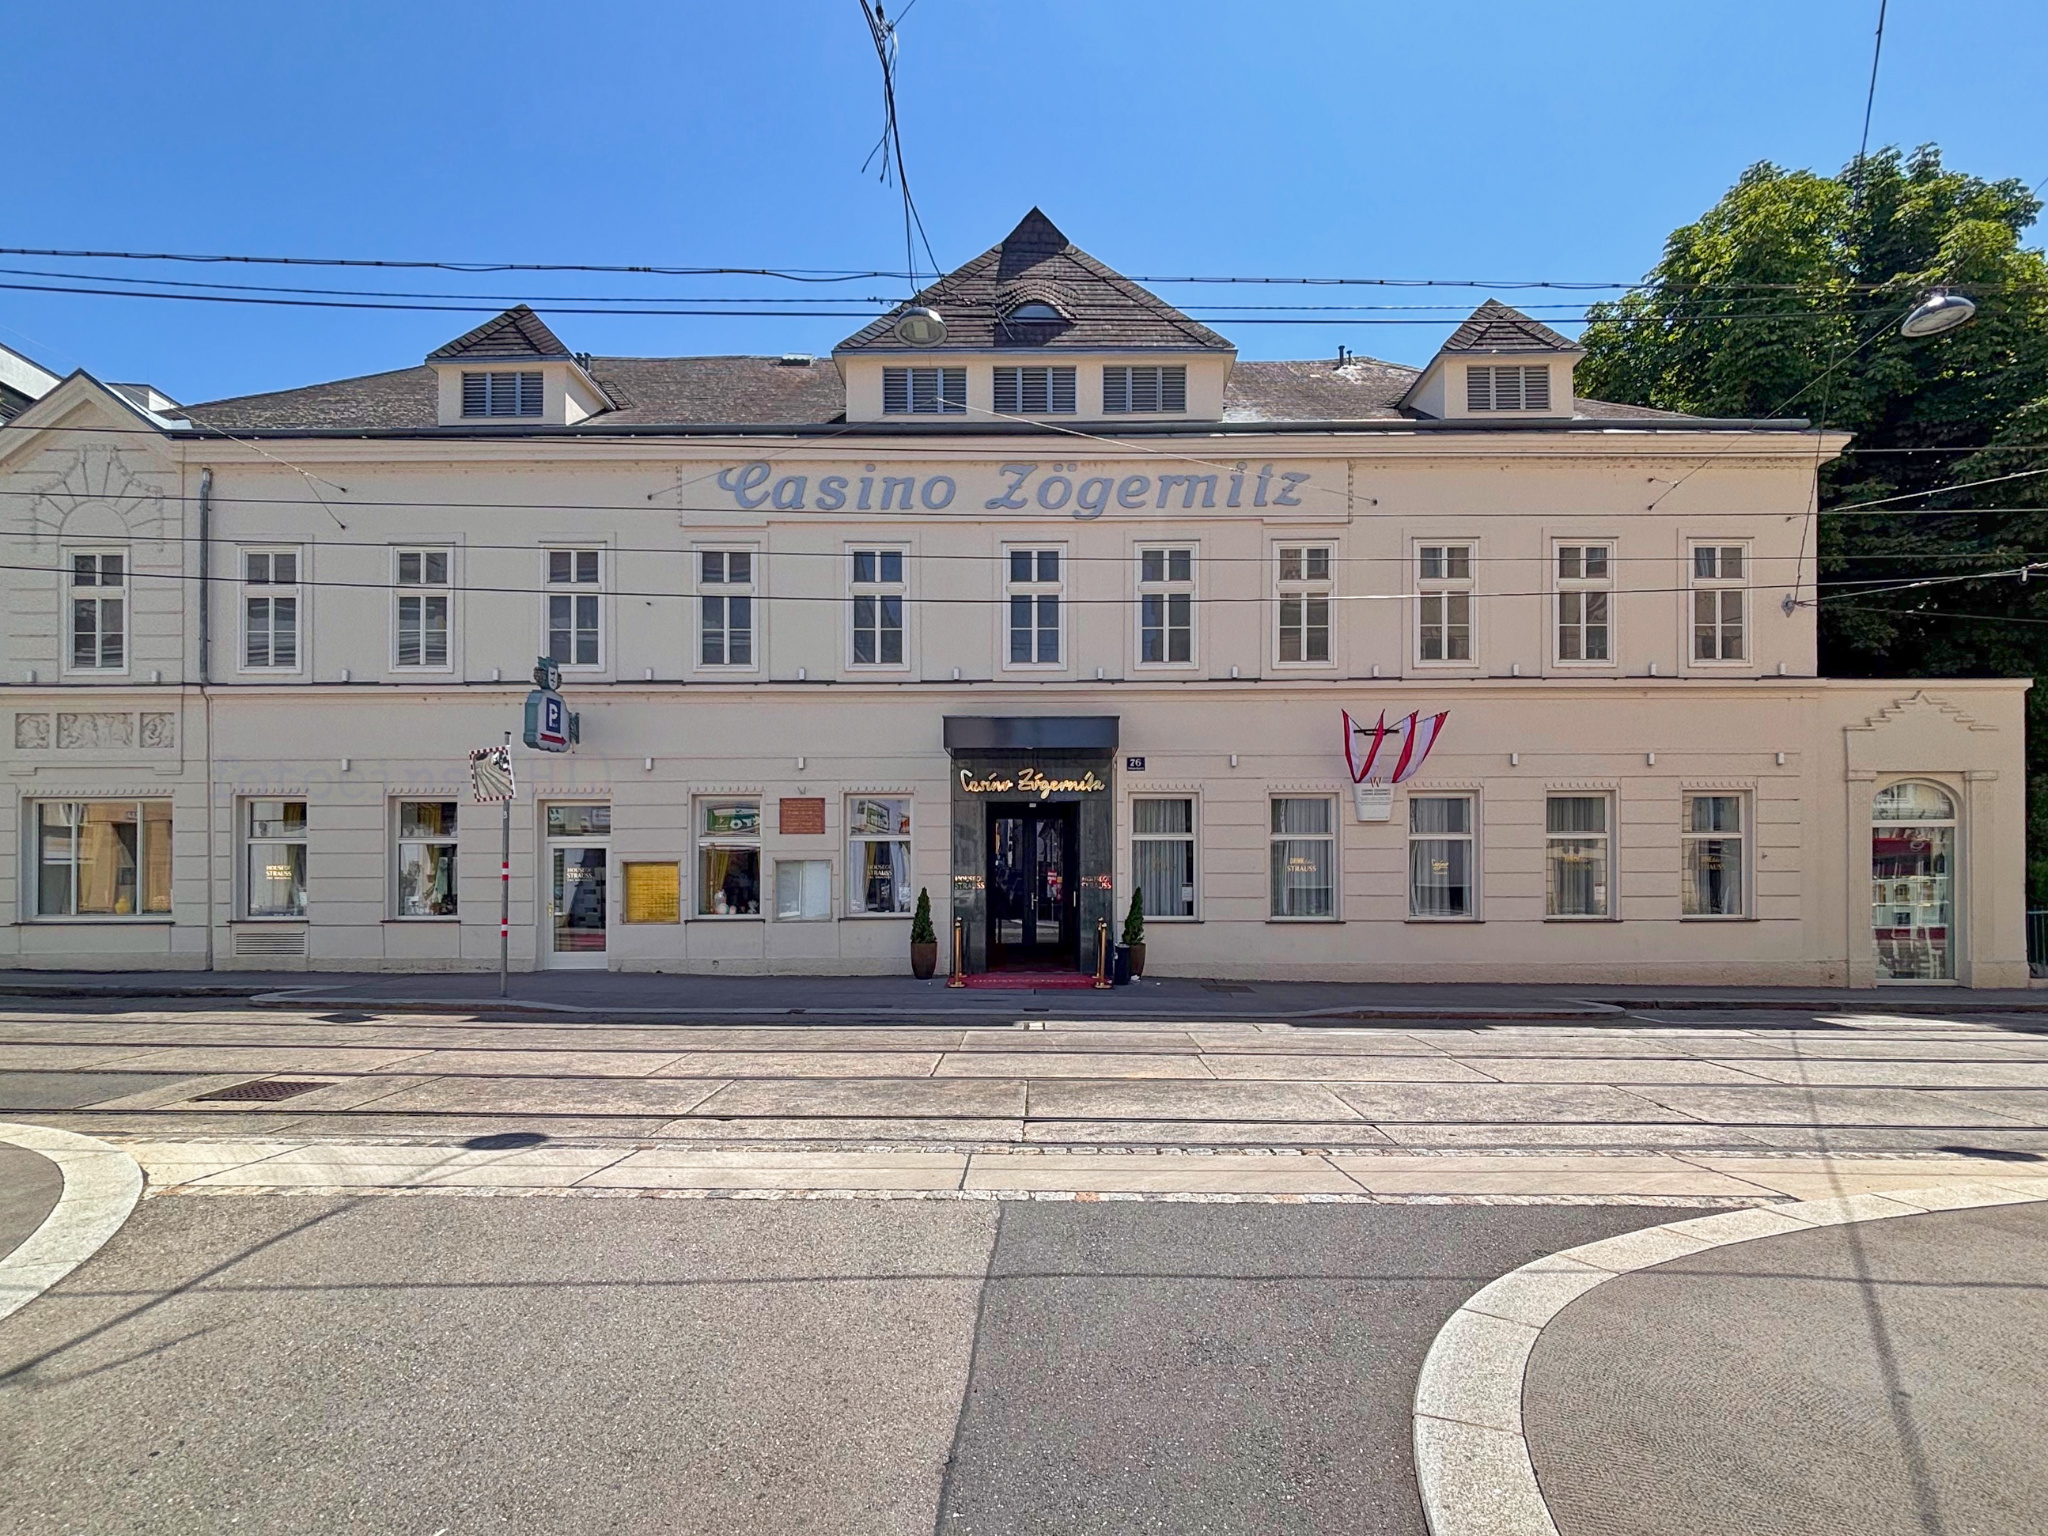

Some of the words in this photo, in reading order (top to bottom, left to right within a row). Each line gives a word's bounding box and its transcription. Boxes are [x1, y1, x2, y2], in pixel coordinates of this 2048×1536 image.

[717, 461, 956, 511] Casino
[985, 461, 1312, 520] Zögernitz
[548, 703, 559, 727] P
[1129, 758, 1142, 767] 76
[960, 768, 1014, 793] Casino
[954, 881, 986, 889] STRAUSS
